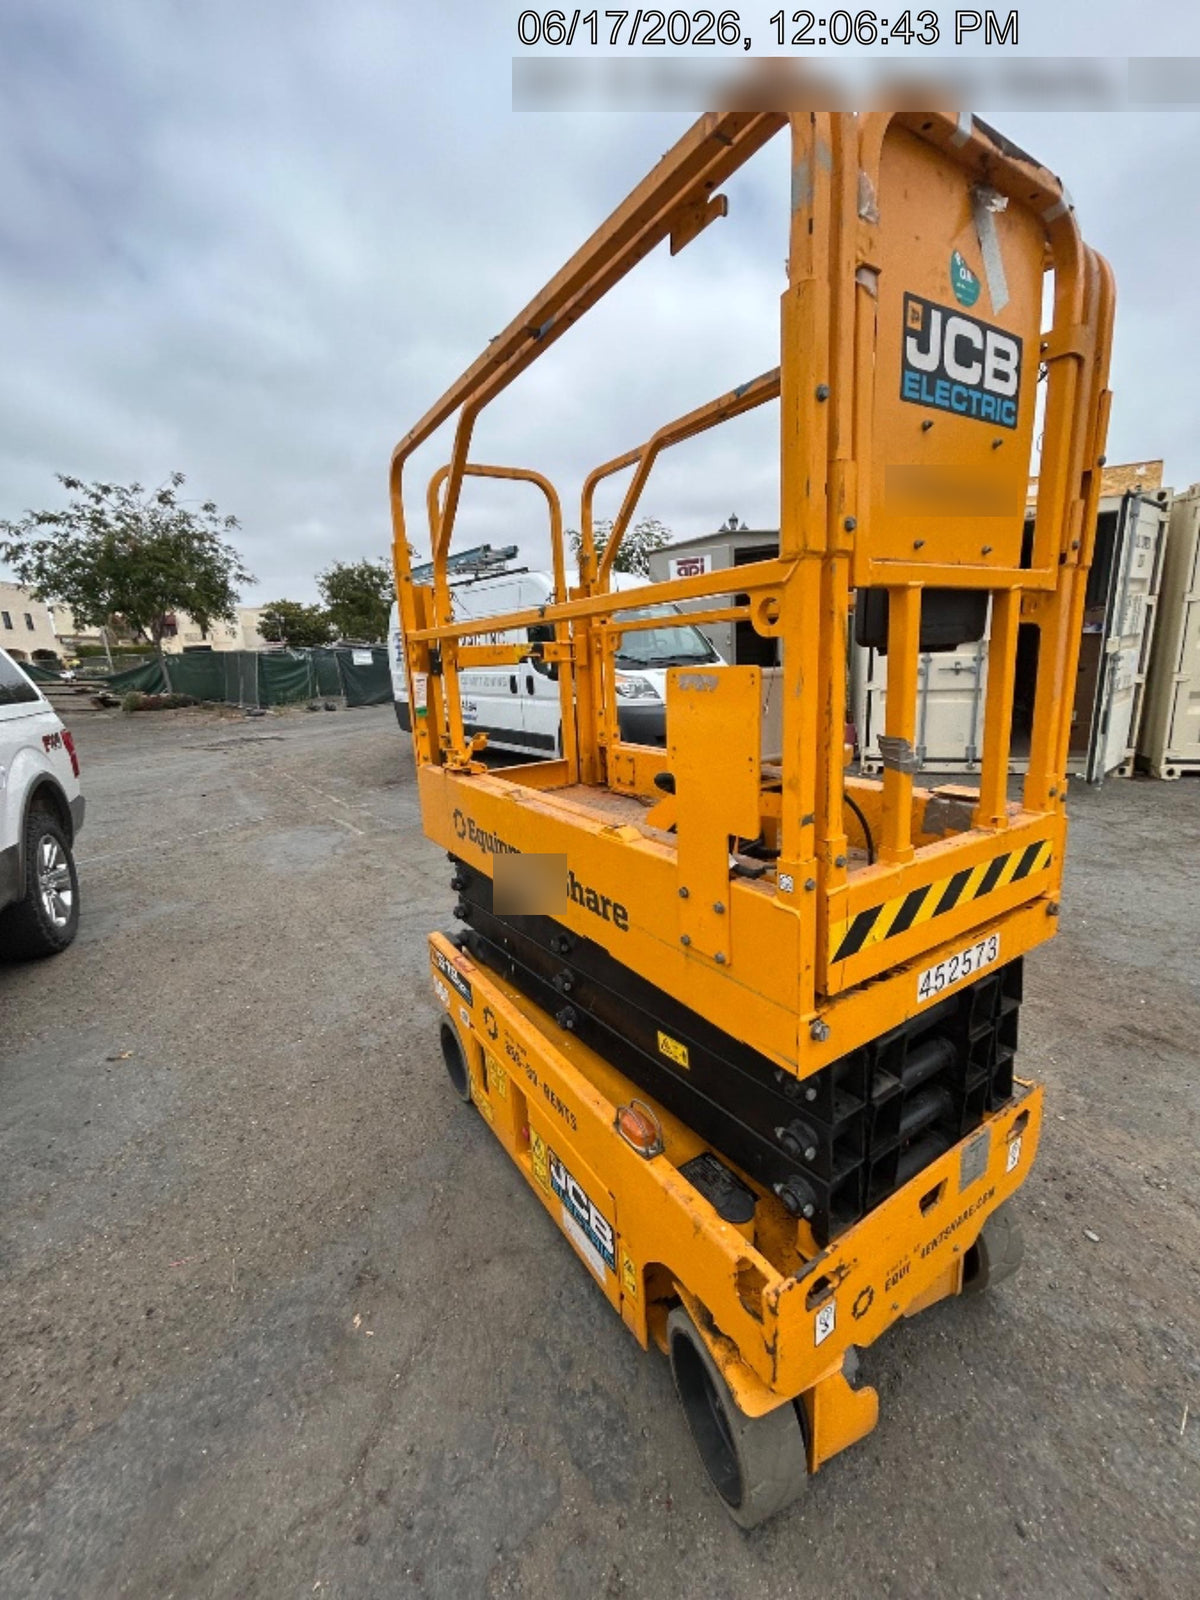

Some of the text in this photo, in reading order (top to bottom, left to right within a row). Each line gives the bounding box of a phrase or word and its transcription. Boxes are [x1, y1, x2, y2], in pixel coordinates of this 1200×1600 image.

[906, 308, 1019, 396] JCB
[903, 371, 1016, 425] ELECTRIC
[918, 936, 998, 998] 452573
[550, 1162, 614, 1255] JCB
